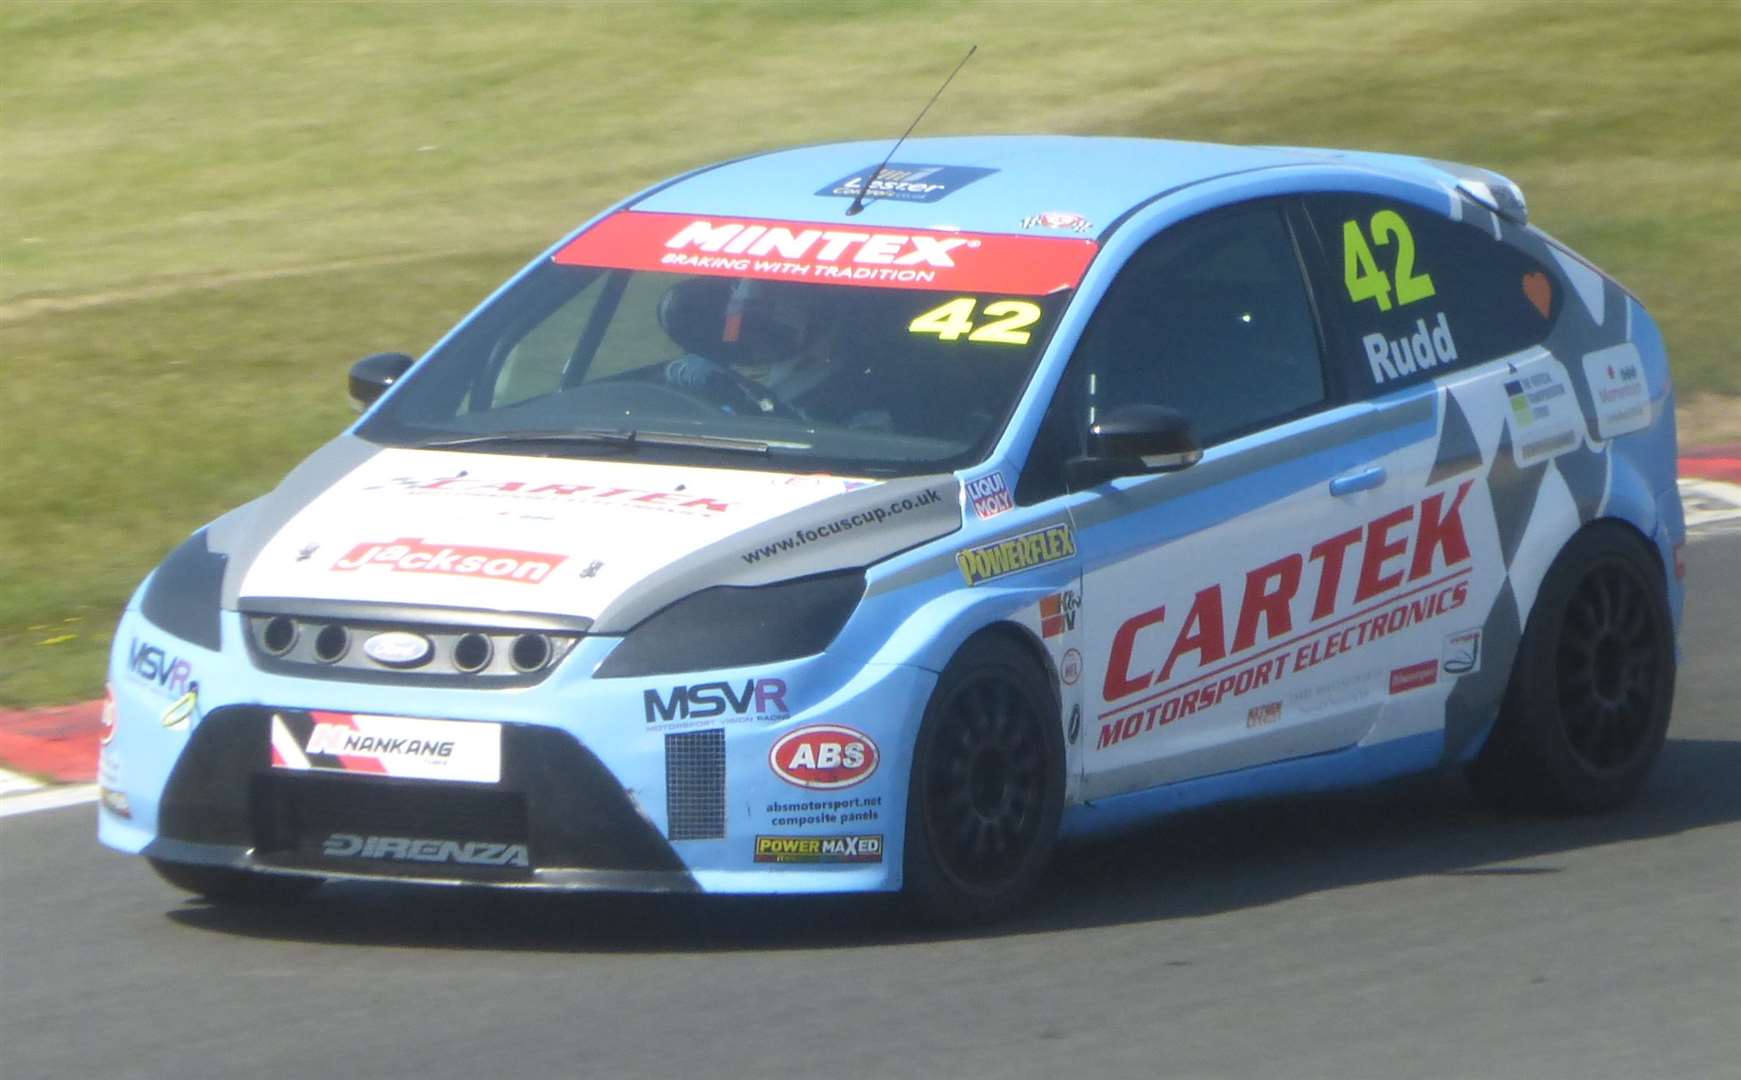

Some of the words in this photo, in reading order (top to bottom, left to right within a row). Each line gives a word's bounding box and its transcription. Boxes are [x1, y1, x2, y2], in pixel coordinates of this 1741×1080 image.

[661, 253, 748, 271] BRAKING
[753, 260, 812, 276] WITH
[814, 264, 935, 282] TRADITION
[1343, 209, 1436, 312] 42
[909, 297, 1041, 345] 42
[1362, 312, 1458, 383] Rudd
[967, 474, 1006, 499] LIQUI
[974, 491, 1013, 517] MOLY
[742, 487, 942, 565] www.focuscup.co.uk
[334, 544, 551, 580] jackson
[958, 526, 1075, 586] POWERFLEX
[1102, 478, 1475, 702] CARTEK
[1097, 653, 1290, 750] MOTORSPORT
[1292, 580, 1469, 673] ELECTRONICS
[643, 678, 789, 723] MSVR
[343, 734, 456, 758] NANKANG
[788, 743, 865, 769] ABS
[766, 797, 882, 814] absmotorsport.net
[771, 813, 836, 828] composite
[840, 809, 879, 825] panels
[323, 834, 529, 867] DIRENZA
[759, 838, 819, 853] POWER
